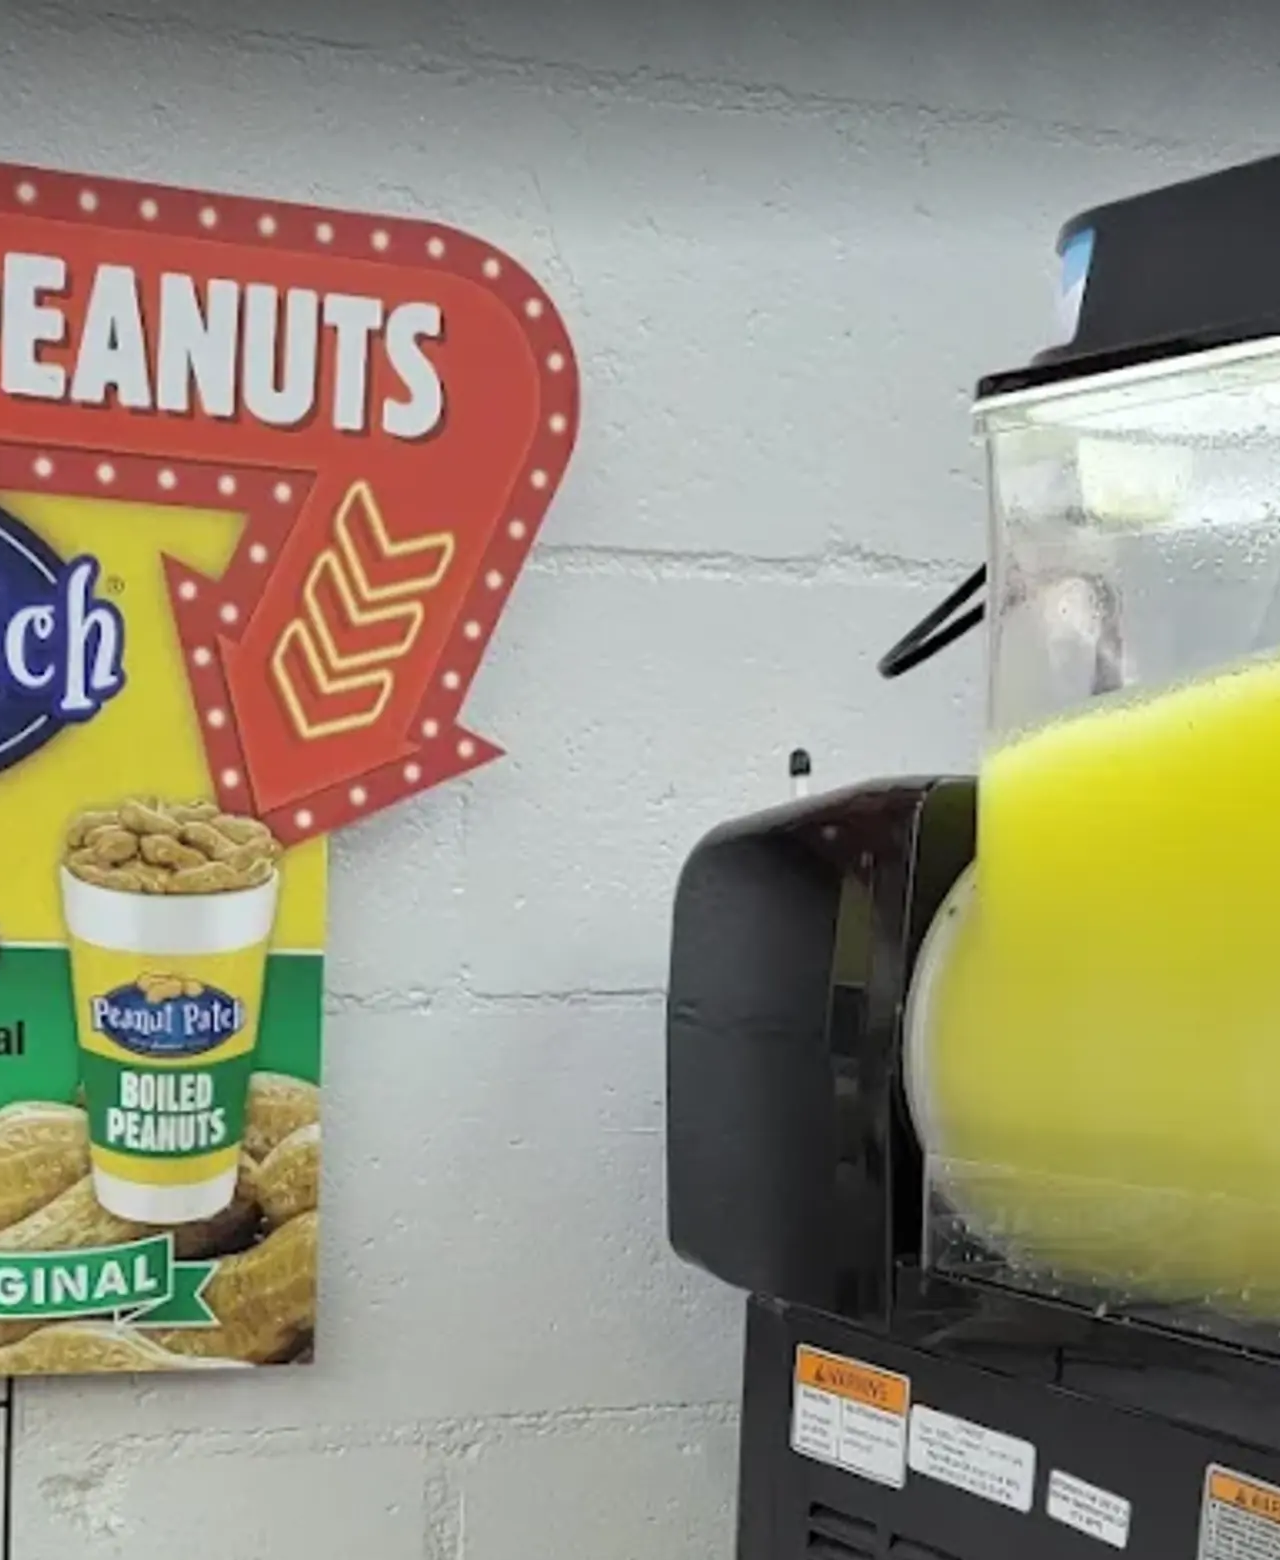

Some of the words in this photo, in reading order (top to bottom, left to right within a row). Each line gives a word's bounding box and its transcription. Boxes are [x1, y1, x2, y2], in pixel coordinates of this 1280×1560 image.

[93, 997, 173, 1034] Peanut
[121, 1071, 214, 1111] BOILED
[107, 1107, 227, 1151] PEANUTS
